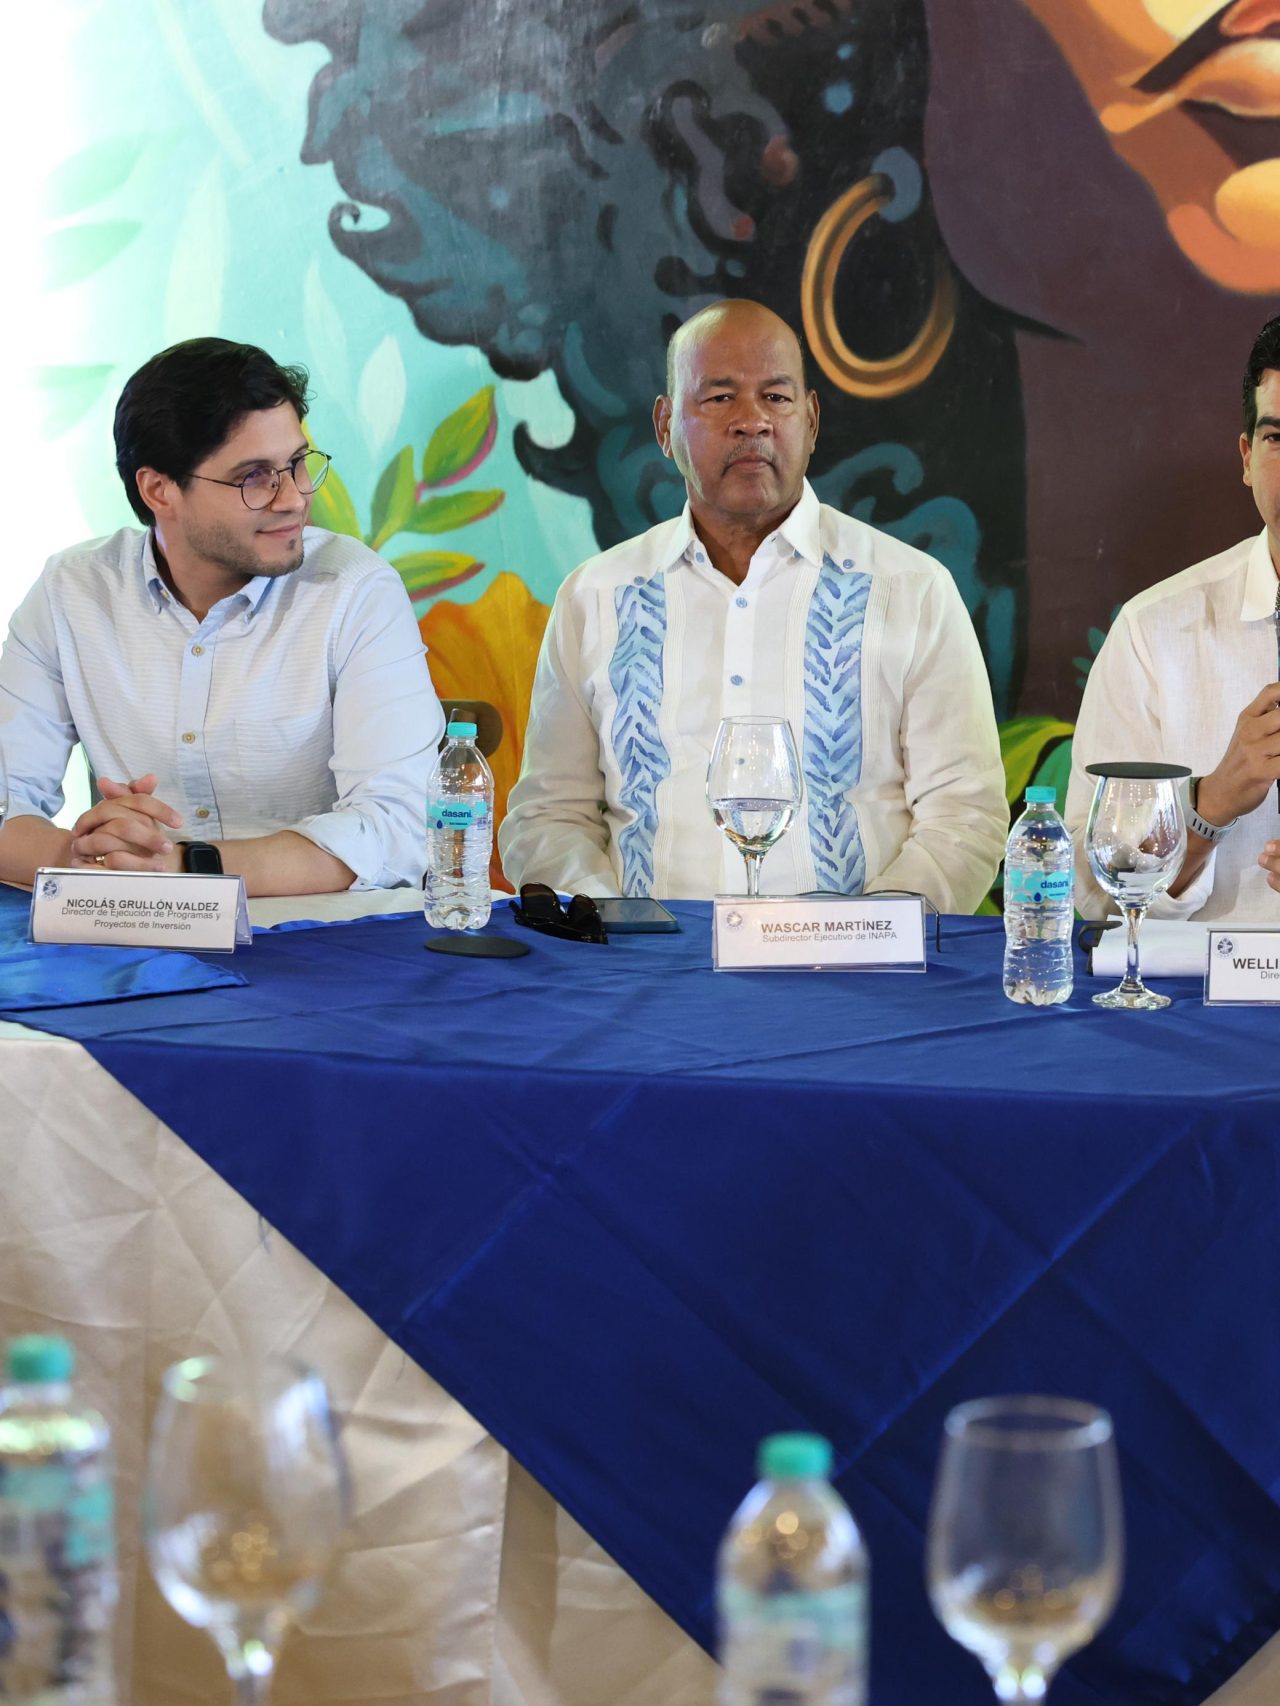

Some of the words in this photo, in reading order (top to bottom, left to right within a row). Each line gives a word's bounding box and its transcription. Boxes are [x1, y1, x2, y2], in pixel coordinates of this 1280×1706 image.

[441, 809, 472, 818] dasani
[67, 897, 115, 909] NICOLÁS
[118, 898, 173, 911] GRULLÓN
[176, 901, 219, 911] VALDEZ
[62, 907, 95, 916] Director
[97, 907, 108, 916] de
[110, 907, 150, 919] Ejecución
[153, 908, 164, 918] de
[167, 910, 213, 920] Programas
[216, 912, 221, 920] y
[94, 919, 136, 929] Proyectos
[138, 920, 149, 929] de
[152, 920, 191, 931] Inversión
[761, 922, 820, 933] WASCAR
[824, 919, 893, 932] MARTÍNEZ
[762, 933, 812, 943] Subdirector
[814, 933, 853, 943] Ejecutivo
[855, 932, 866, 940] de
[868, 931, 897, 940] INAPA
